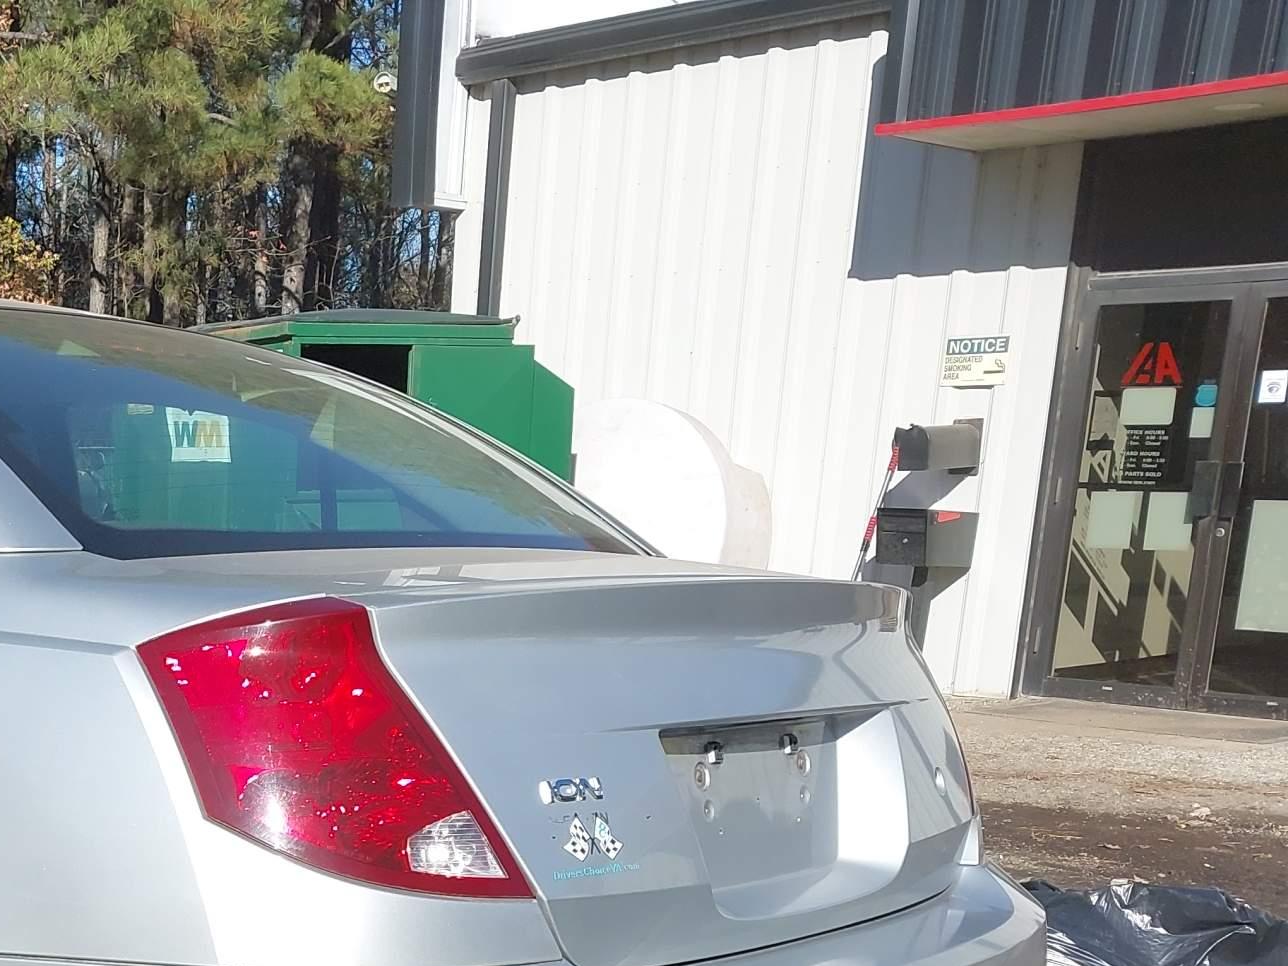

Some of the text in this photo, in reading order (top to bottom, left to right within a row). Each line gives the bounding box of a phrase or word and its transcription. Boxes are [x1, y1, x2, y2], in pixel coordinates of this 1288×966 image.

[949, 339, 1007, 353] NOTICE
[945, 356, 983, 364] DESIGNATED
[944, 364, 972, 372] SMOKING
[943, 372, 959, 380] AREA
[173, 420, 224, 448] WM
[539, 776, 604, 805] ION
